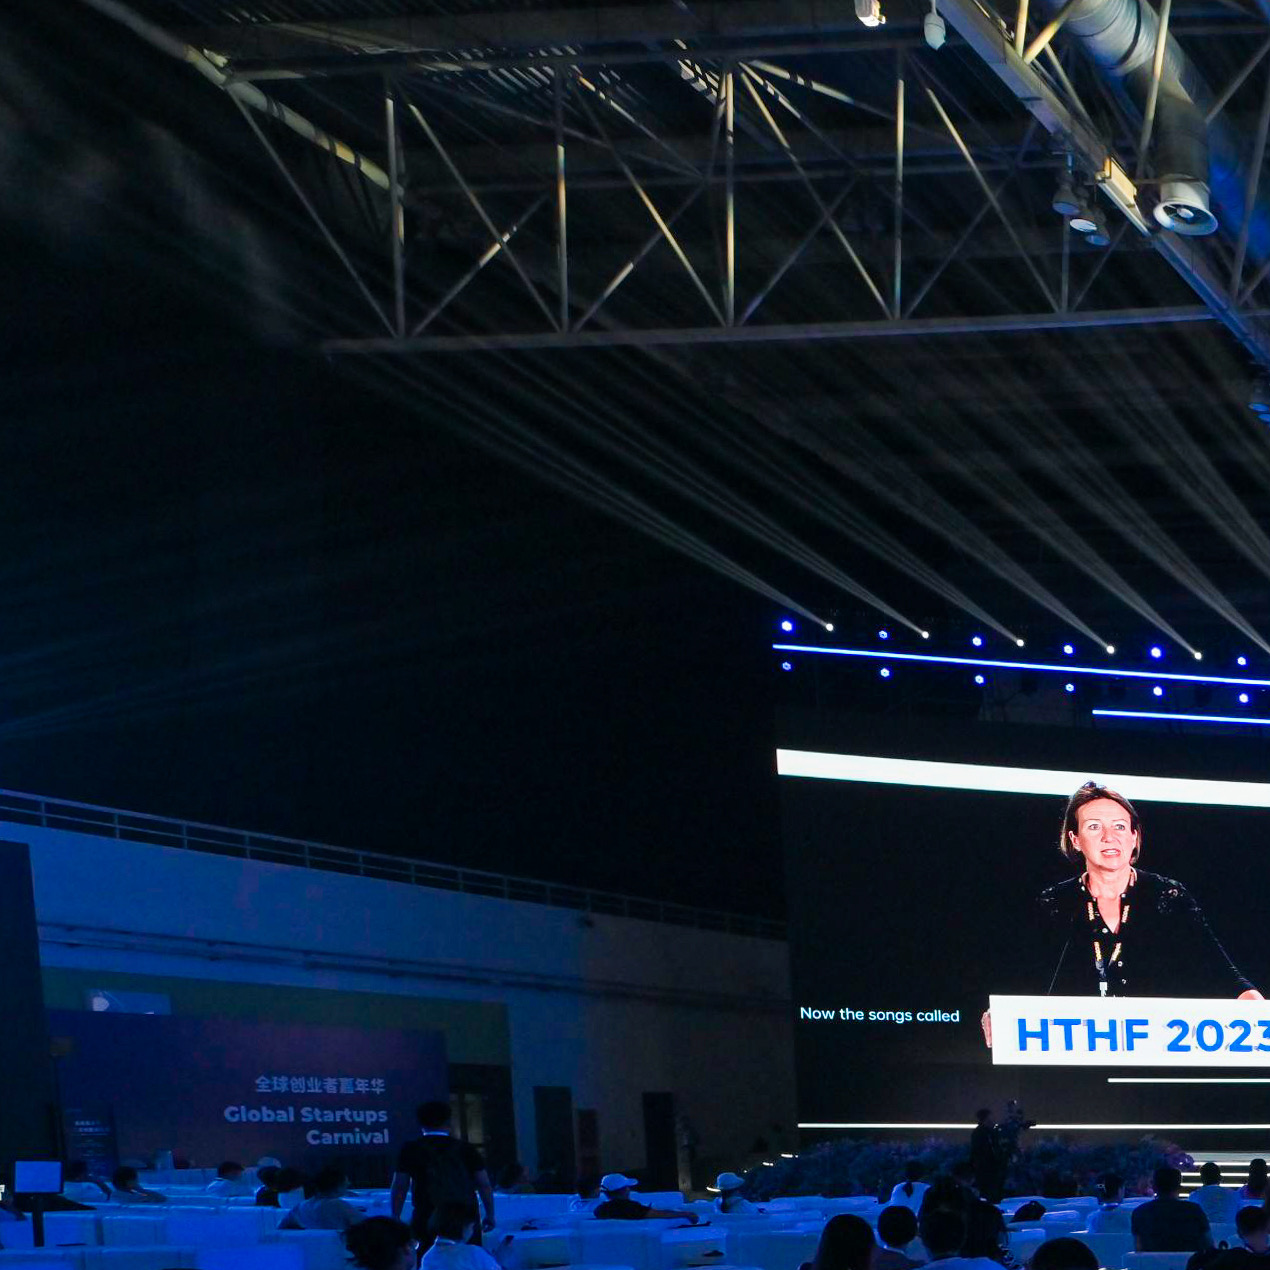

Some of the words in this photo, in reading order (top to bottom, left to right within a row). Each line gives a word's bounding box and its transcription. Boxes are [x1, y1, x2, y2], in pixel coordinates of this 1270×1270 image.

[800, 1006, 836, 1020] Now
[839, 1007, 865, 1021] the
[868, 1010, 913, 1024] songs
[916, 1009, 960, 1023] called
[1017, 1018, 1149, 1052] HTHF
[255, 1075, 385, 1095] 全球创业者嘉年华
[223, 1105, 295, 1123] Global
[300, 1106, 388, 1126] Startups
[306, 1127, 390, 1145] Carnival
